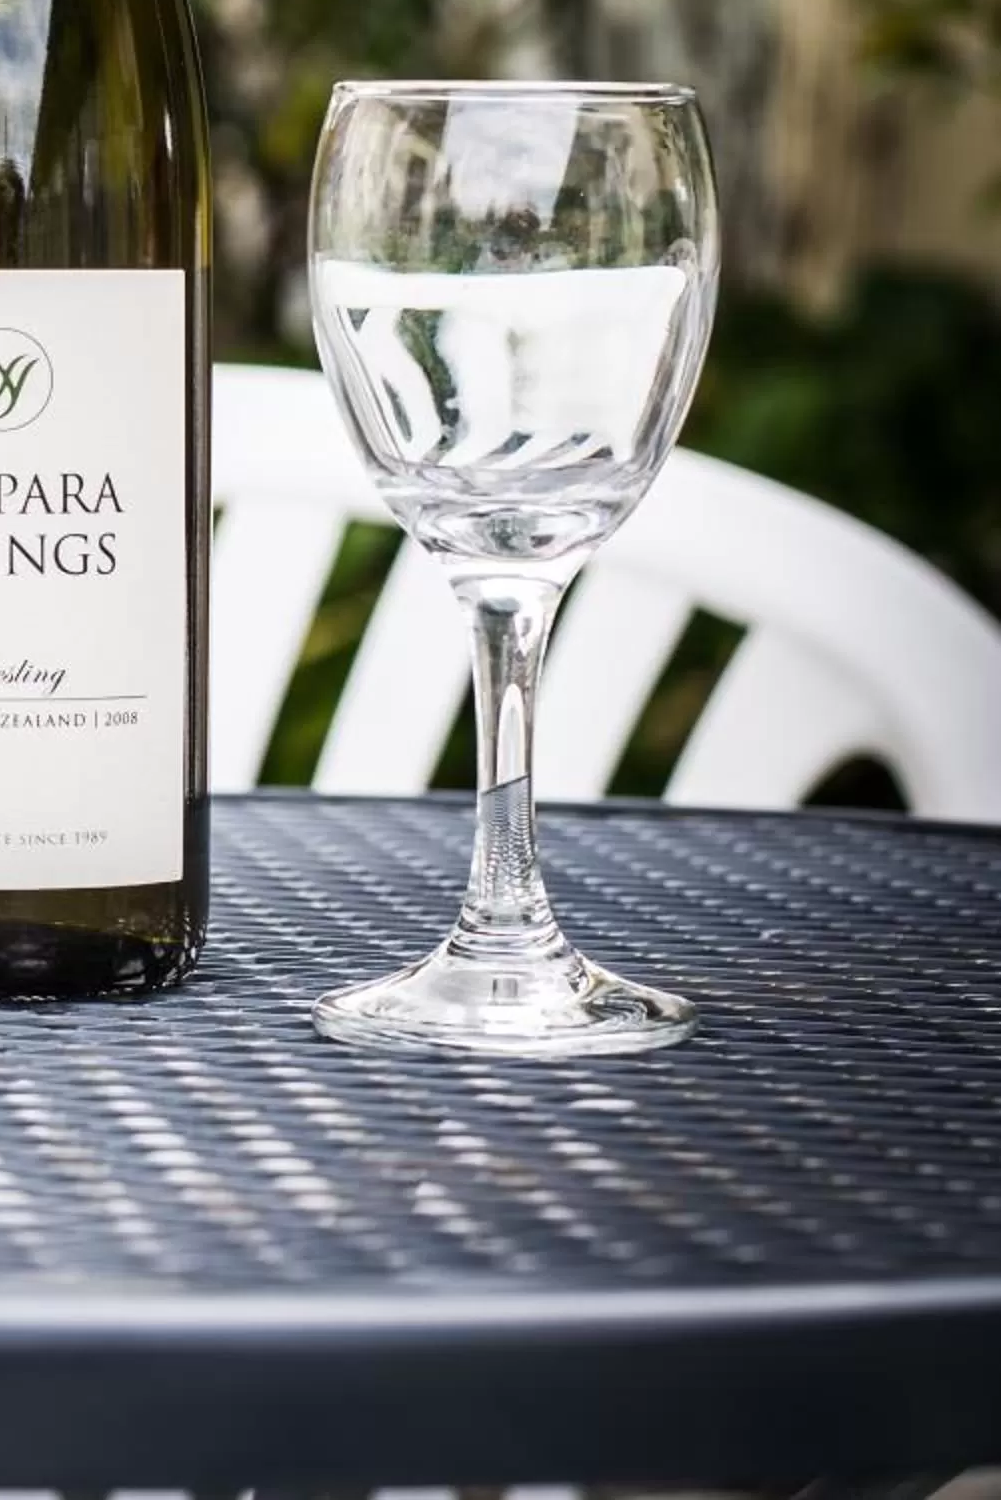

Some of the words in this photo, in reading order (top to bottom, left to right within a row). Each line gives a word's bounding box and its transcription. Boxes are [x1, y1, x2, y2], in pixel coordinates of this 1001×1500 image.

[0, 712, 87, 729] ZEALAND
[105, 710, 139, 727] 2008
[19, 832, 67, 846] SINCE
